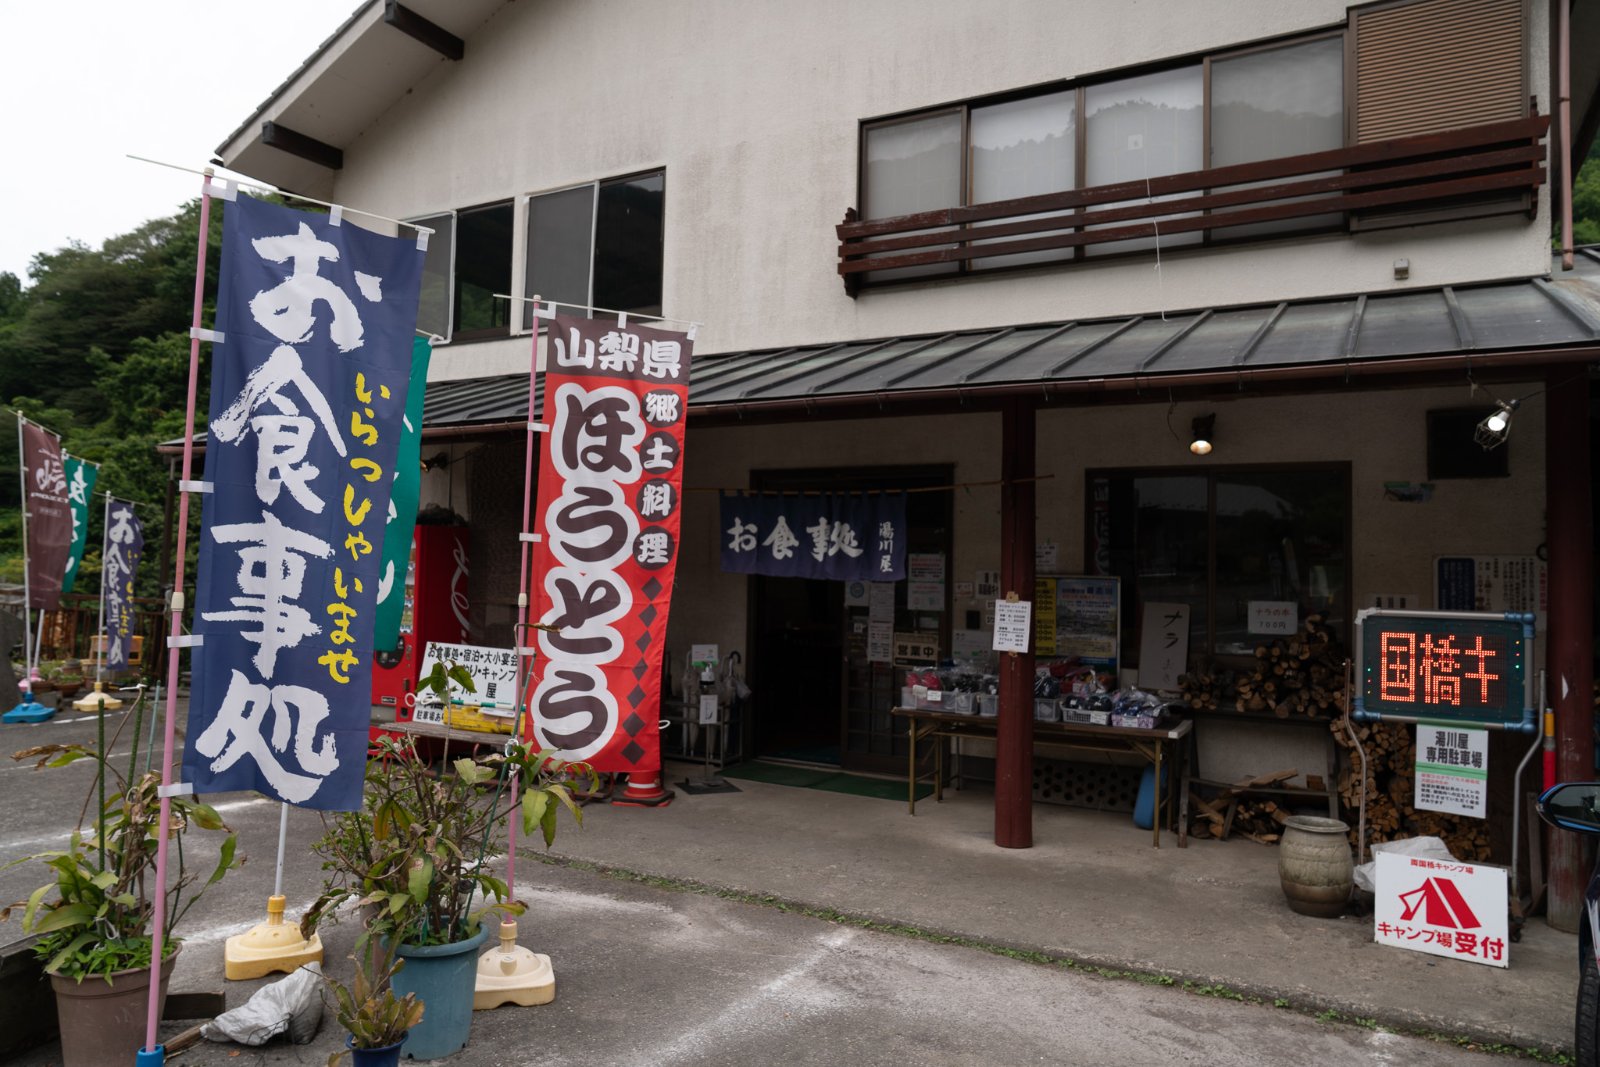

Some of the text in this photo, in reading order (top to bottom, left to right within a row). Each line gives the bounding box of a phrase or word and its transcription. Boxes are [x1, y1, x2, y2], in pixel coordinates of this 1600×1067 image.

[554, 327, 682, 378] 山梨県
[638, 391, 681, 564] 郷土料理
[195, 220, 383, 803] お食事処
[727, 515, 864, 562] お食事処
[879, 521, 894, 572] 湯川屋
[534, 386, 643, 758] ほうとう
[897, 644, 934, 657] 営業中
[1381, 632, 1499, 705] 国橋キ
[1426, 746, 1483, 768] 専用駐車場
[1435, 731, 1469, 749] 湯川屋
[1410, 858, 1474, 875] 両国橋キャンプ場
[1377, 922, 1505, 961] キャンプ場受付
